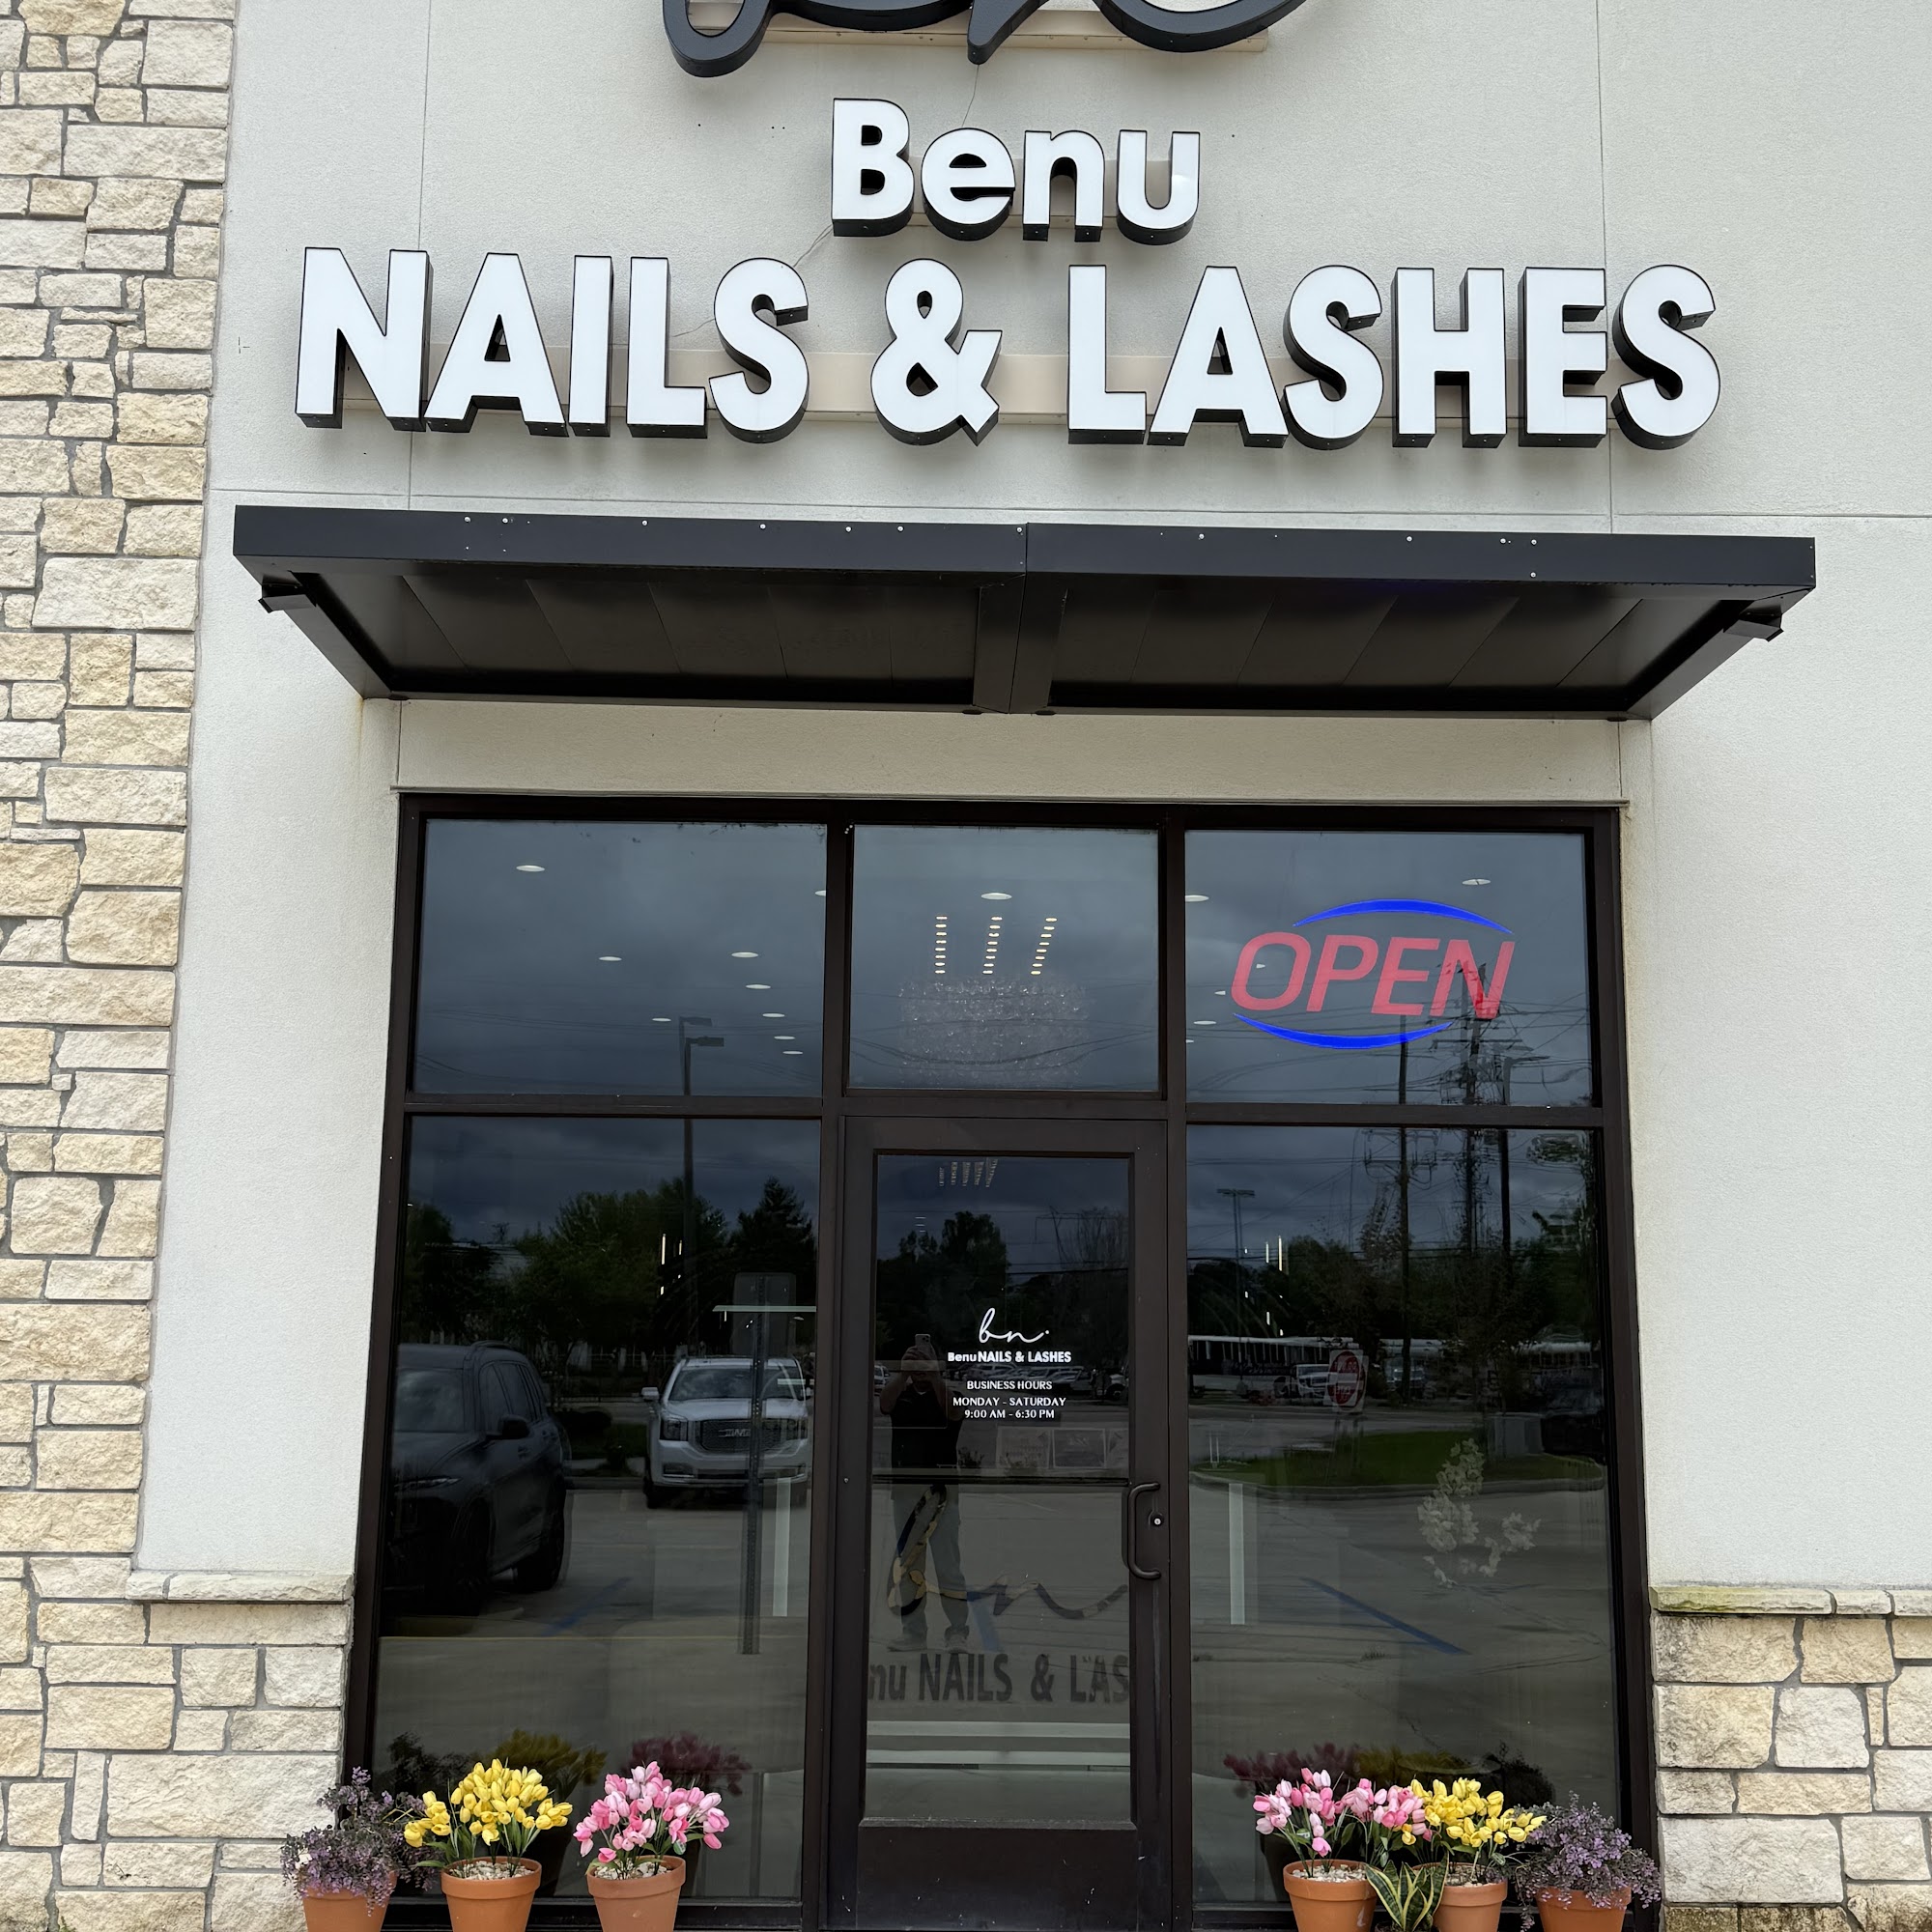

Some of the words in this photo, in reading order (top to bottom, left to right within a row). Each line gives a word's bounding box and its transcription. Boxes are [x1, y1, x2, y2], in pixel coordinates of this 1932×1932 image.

[833, 99, 1201, 245] Benu
[296, 246, 810, 443] NAILS
[871, 258, 1005, 445] &
[1067, 264, 1721, 450] LASHES
[1231, 932, 1515, 1019] OPEN
[947, 1352, 977, 1362] Benu
[978, 1350, 1012, 1363] NAILS
[1015, 1351, 1025, 1363] &
[1028, 1350, 1072, 1363] LASHES
[967, 1380, 1015, 1390] BUSINESS
[1017, 1380, 1053, 1390] HOURS
[952, 1397, 1000, 1406] MONDAY
[1009, 1397, 1066, 1406] SATURDAY
[964, 1409, 987, 1419] 9:00
[989, 1409, 1006, 1419] AM
[1015, 1409, 1037, 1419] 6:30
[1038, 1409, 1055, 1419] PM
[919, 1653, 1013, 1702] NAILS
[1030, 1653, 1055, 1702] &
